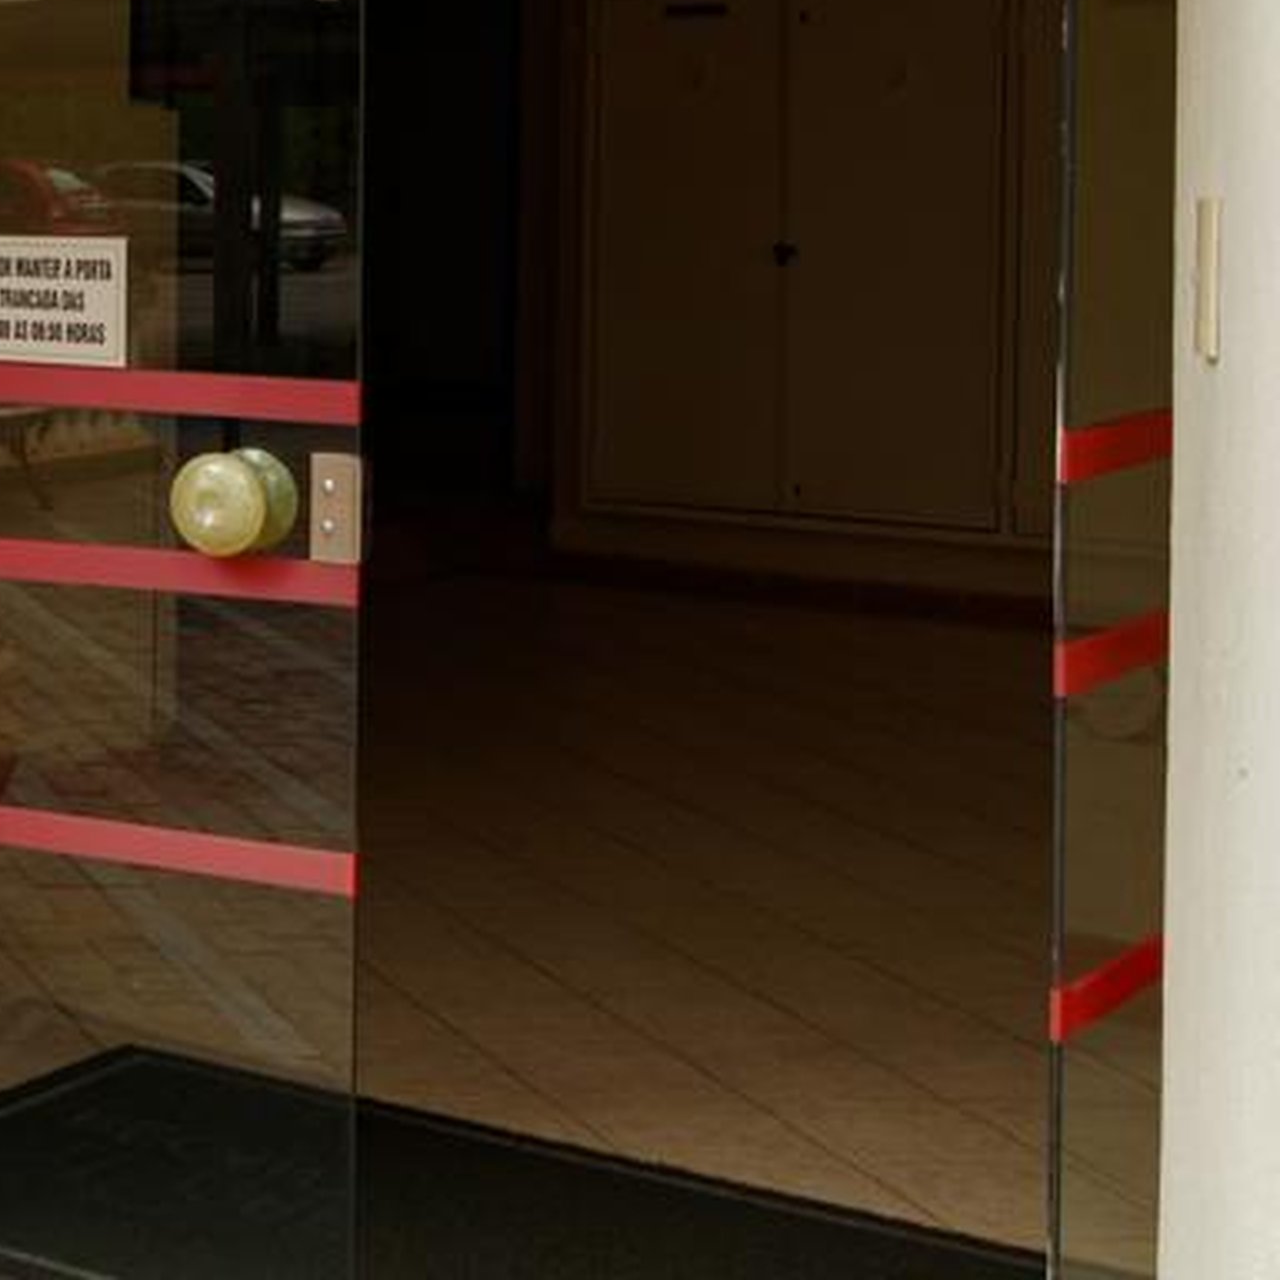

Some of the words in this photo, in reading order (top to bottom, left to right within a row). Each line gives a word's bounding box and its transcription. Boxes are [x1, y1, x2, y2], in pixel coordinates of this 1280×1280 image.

[16, 257, 61, 280] MANTER
[64, 258, 72, 280] A
[75, 258, 112, 281] PORTA
[66, 323, 106, 346] HORAS
